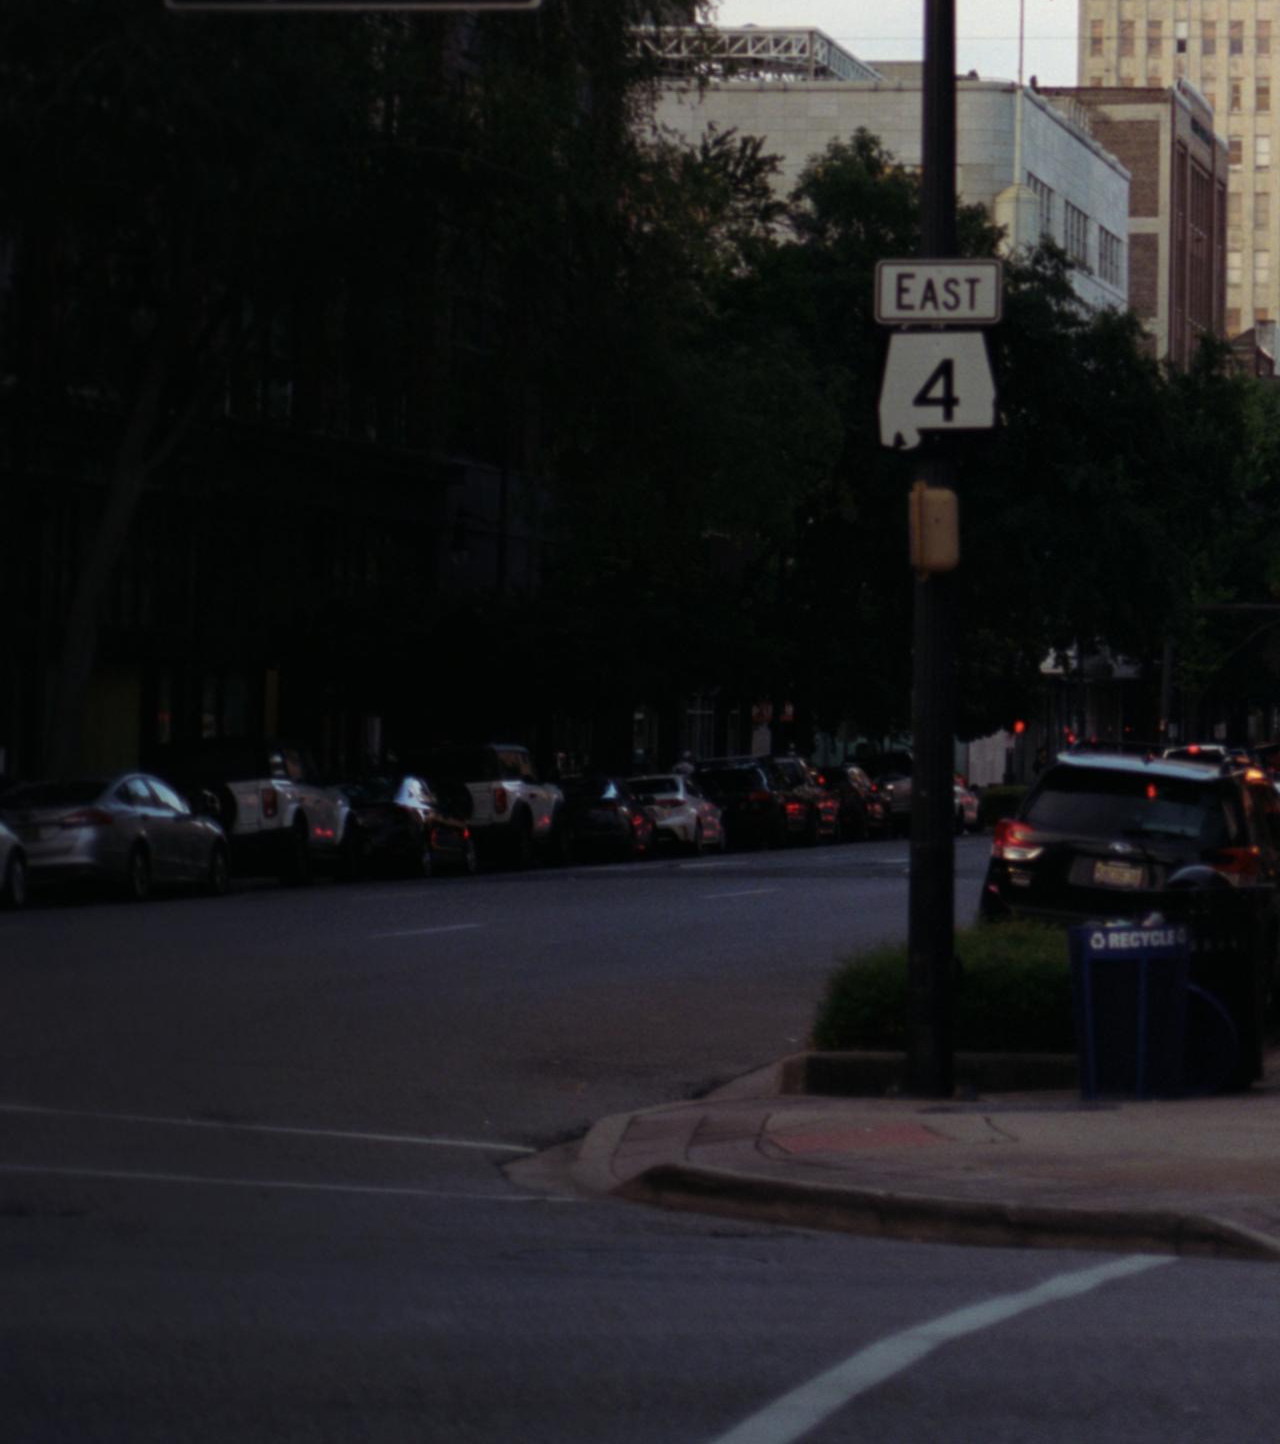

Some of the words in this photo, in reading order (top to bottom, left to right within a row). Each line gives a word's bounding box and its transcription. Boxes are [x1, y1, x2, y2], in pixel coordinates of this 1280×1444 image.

[896, 272, 981, 311] EAST
[912, 358, 960, 422] 4
[1109, 930, 1176, 949] RECYCLE
